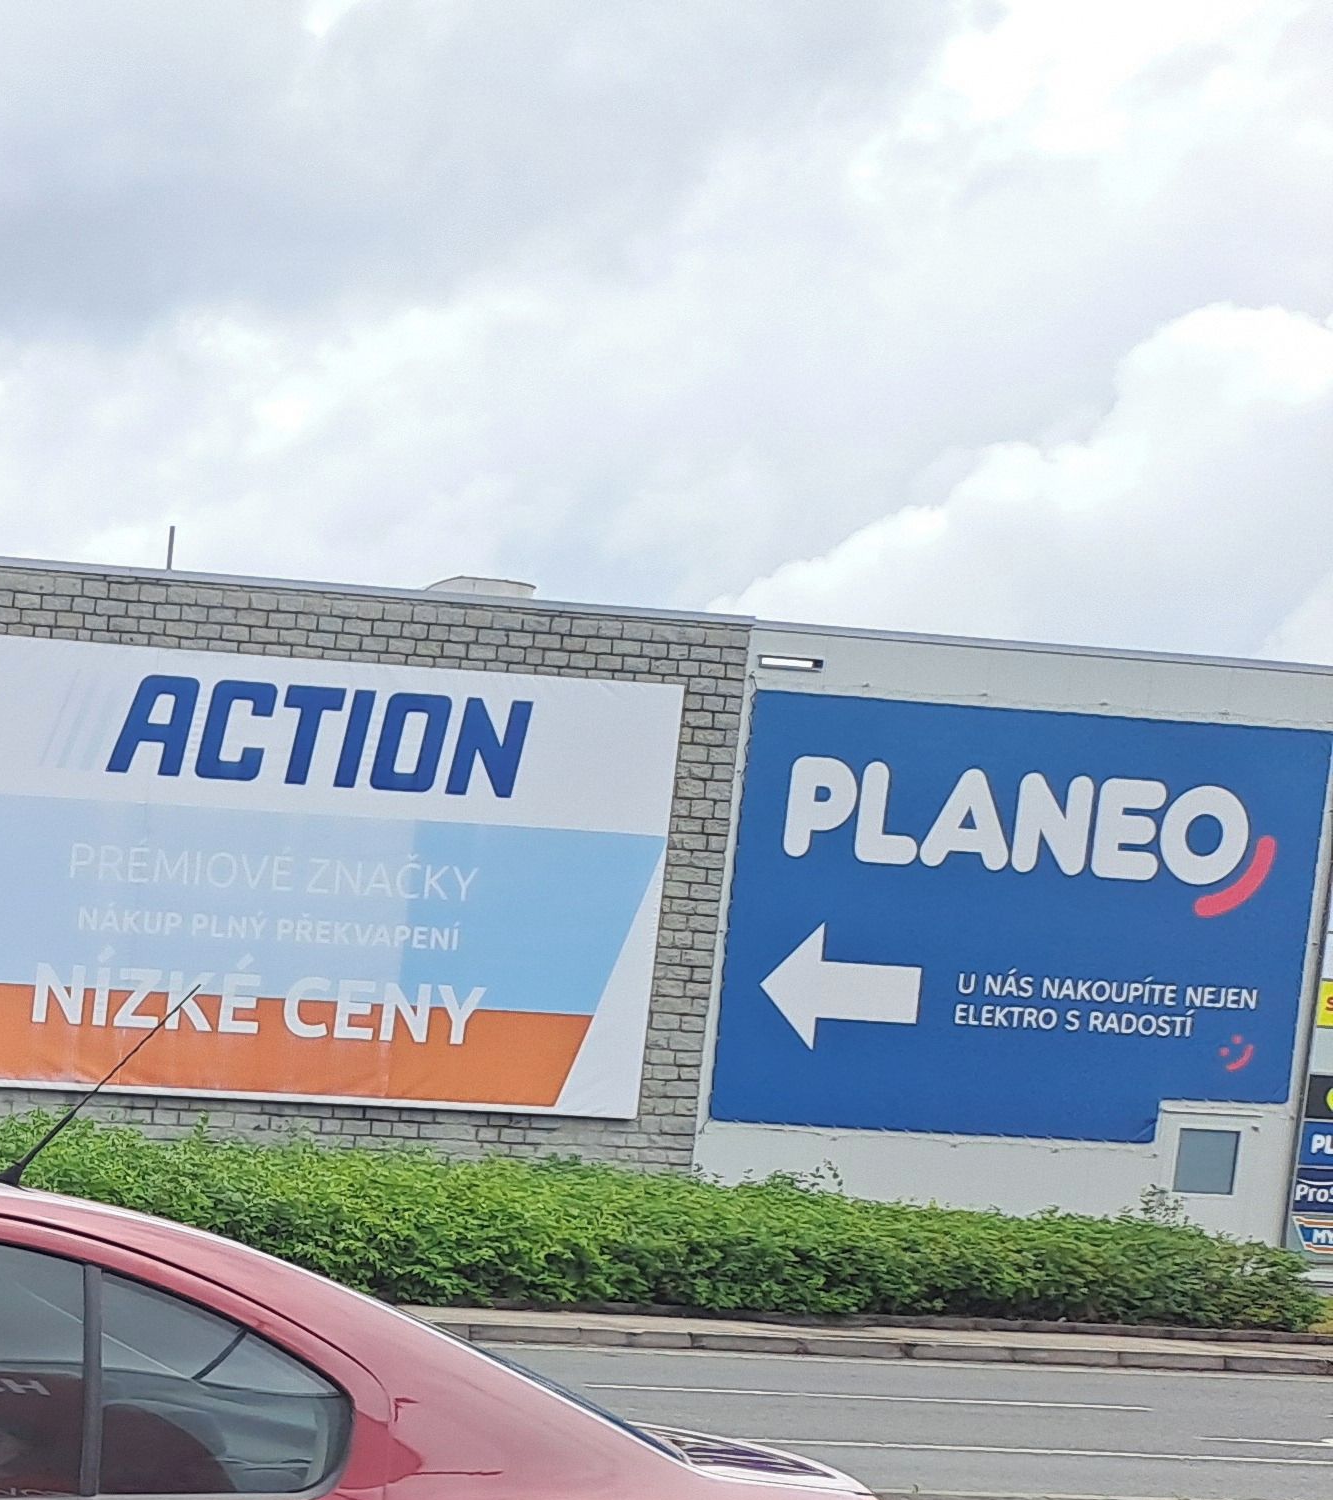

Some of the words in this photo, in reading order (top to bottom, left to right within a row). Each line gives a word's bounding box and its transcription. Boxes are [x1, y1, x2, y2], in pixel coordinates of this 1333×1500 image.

[105, 674, 534, 799] ACTION
[783, 755, 1250, 887] PLANEO
[68, 836, 294, 893] PRÉMIOVÉ
[306, 853, 479, 902] ZNAČKY
[78, 901, 182, 934] NÁKUP
[191, 906, 267, 941] PLNÝ
[277, 913, 460, 951] PŘEKVAPENÍ
[31, 944, 262, 1034] NÍZKÉ
[283, 975, 488, 1046] CENY
[954, 1003, 1058, 1031] ELEKTRO
[1064, 1010, 1081, 1032] S
[1088, 1008, 1196, 1038] RADOSTÍ
[958, 972, 976, 994] U
[984, 967, 1034, 998] NÁS
[1041, 975, 1177, 1006] NAKOUPÍTE
[1184, 985, 1258, 1011] NEJEN
